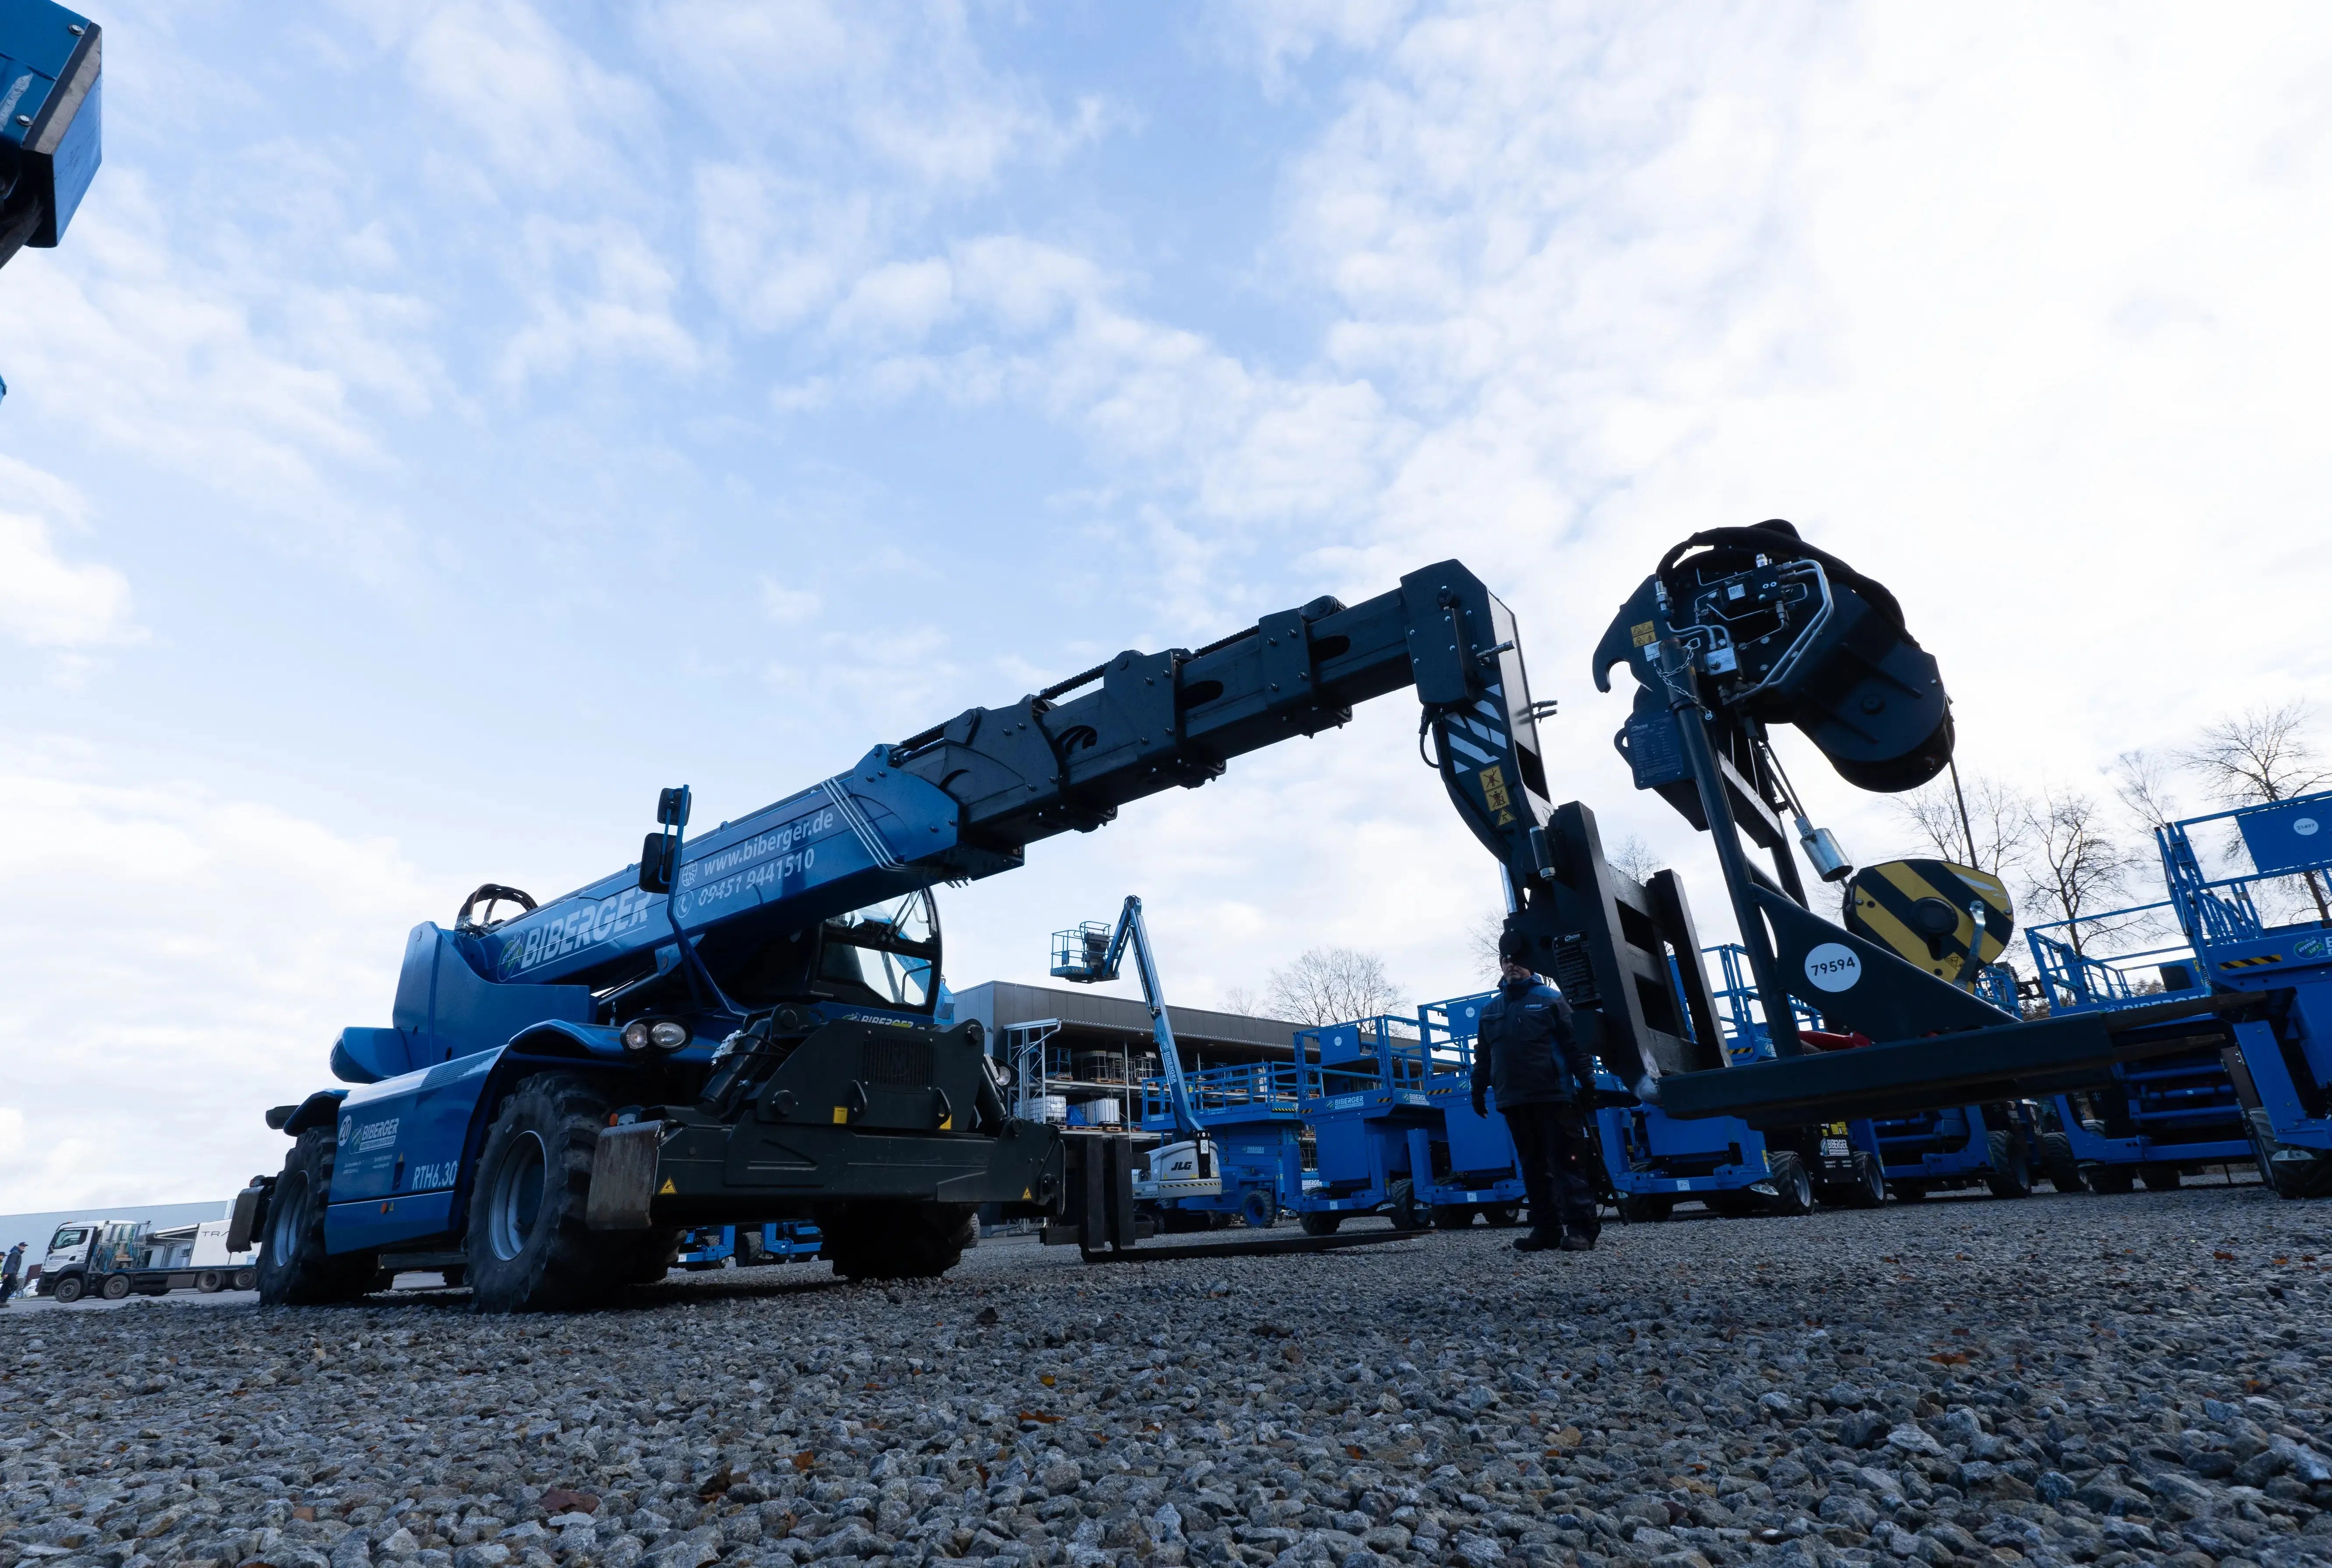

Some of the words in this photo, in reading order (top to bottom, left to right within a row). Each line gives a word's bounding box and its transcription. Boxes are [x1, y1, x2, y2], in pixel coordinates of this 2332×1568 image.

[704, 810, 833, 876] www.biberger.de
[699, 875, 742, 906] 09451
[746, 848, 814, 890] 9441510
[520, 885, 653, 969] BIBERGER
[2299, 940, 2317, 952] SYSTEM
[2309, 945, 2319, 954] LIFT
[1811, 957, 1855, 976] 79594
[1166, 1051, 1177, 1083] BIBERGER
[1335, 1095, 1364, 1105] BIBERGER
[340, 1120, 351, 1142] 20
[362, 1118, 399, 1141] BIBERGER
[1826, 1139, 1848, 1149] BIBERGER
[412, 1160, 458, 1189] RTH6.30
[1170, 1161, 1192, 1171] JLG
